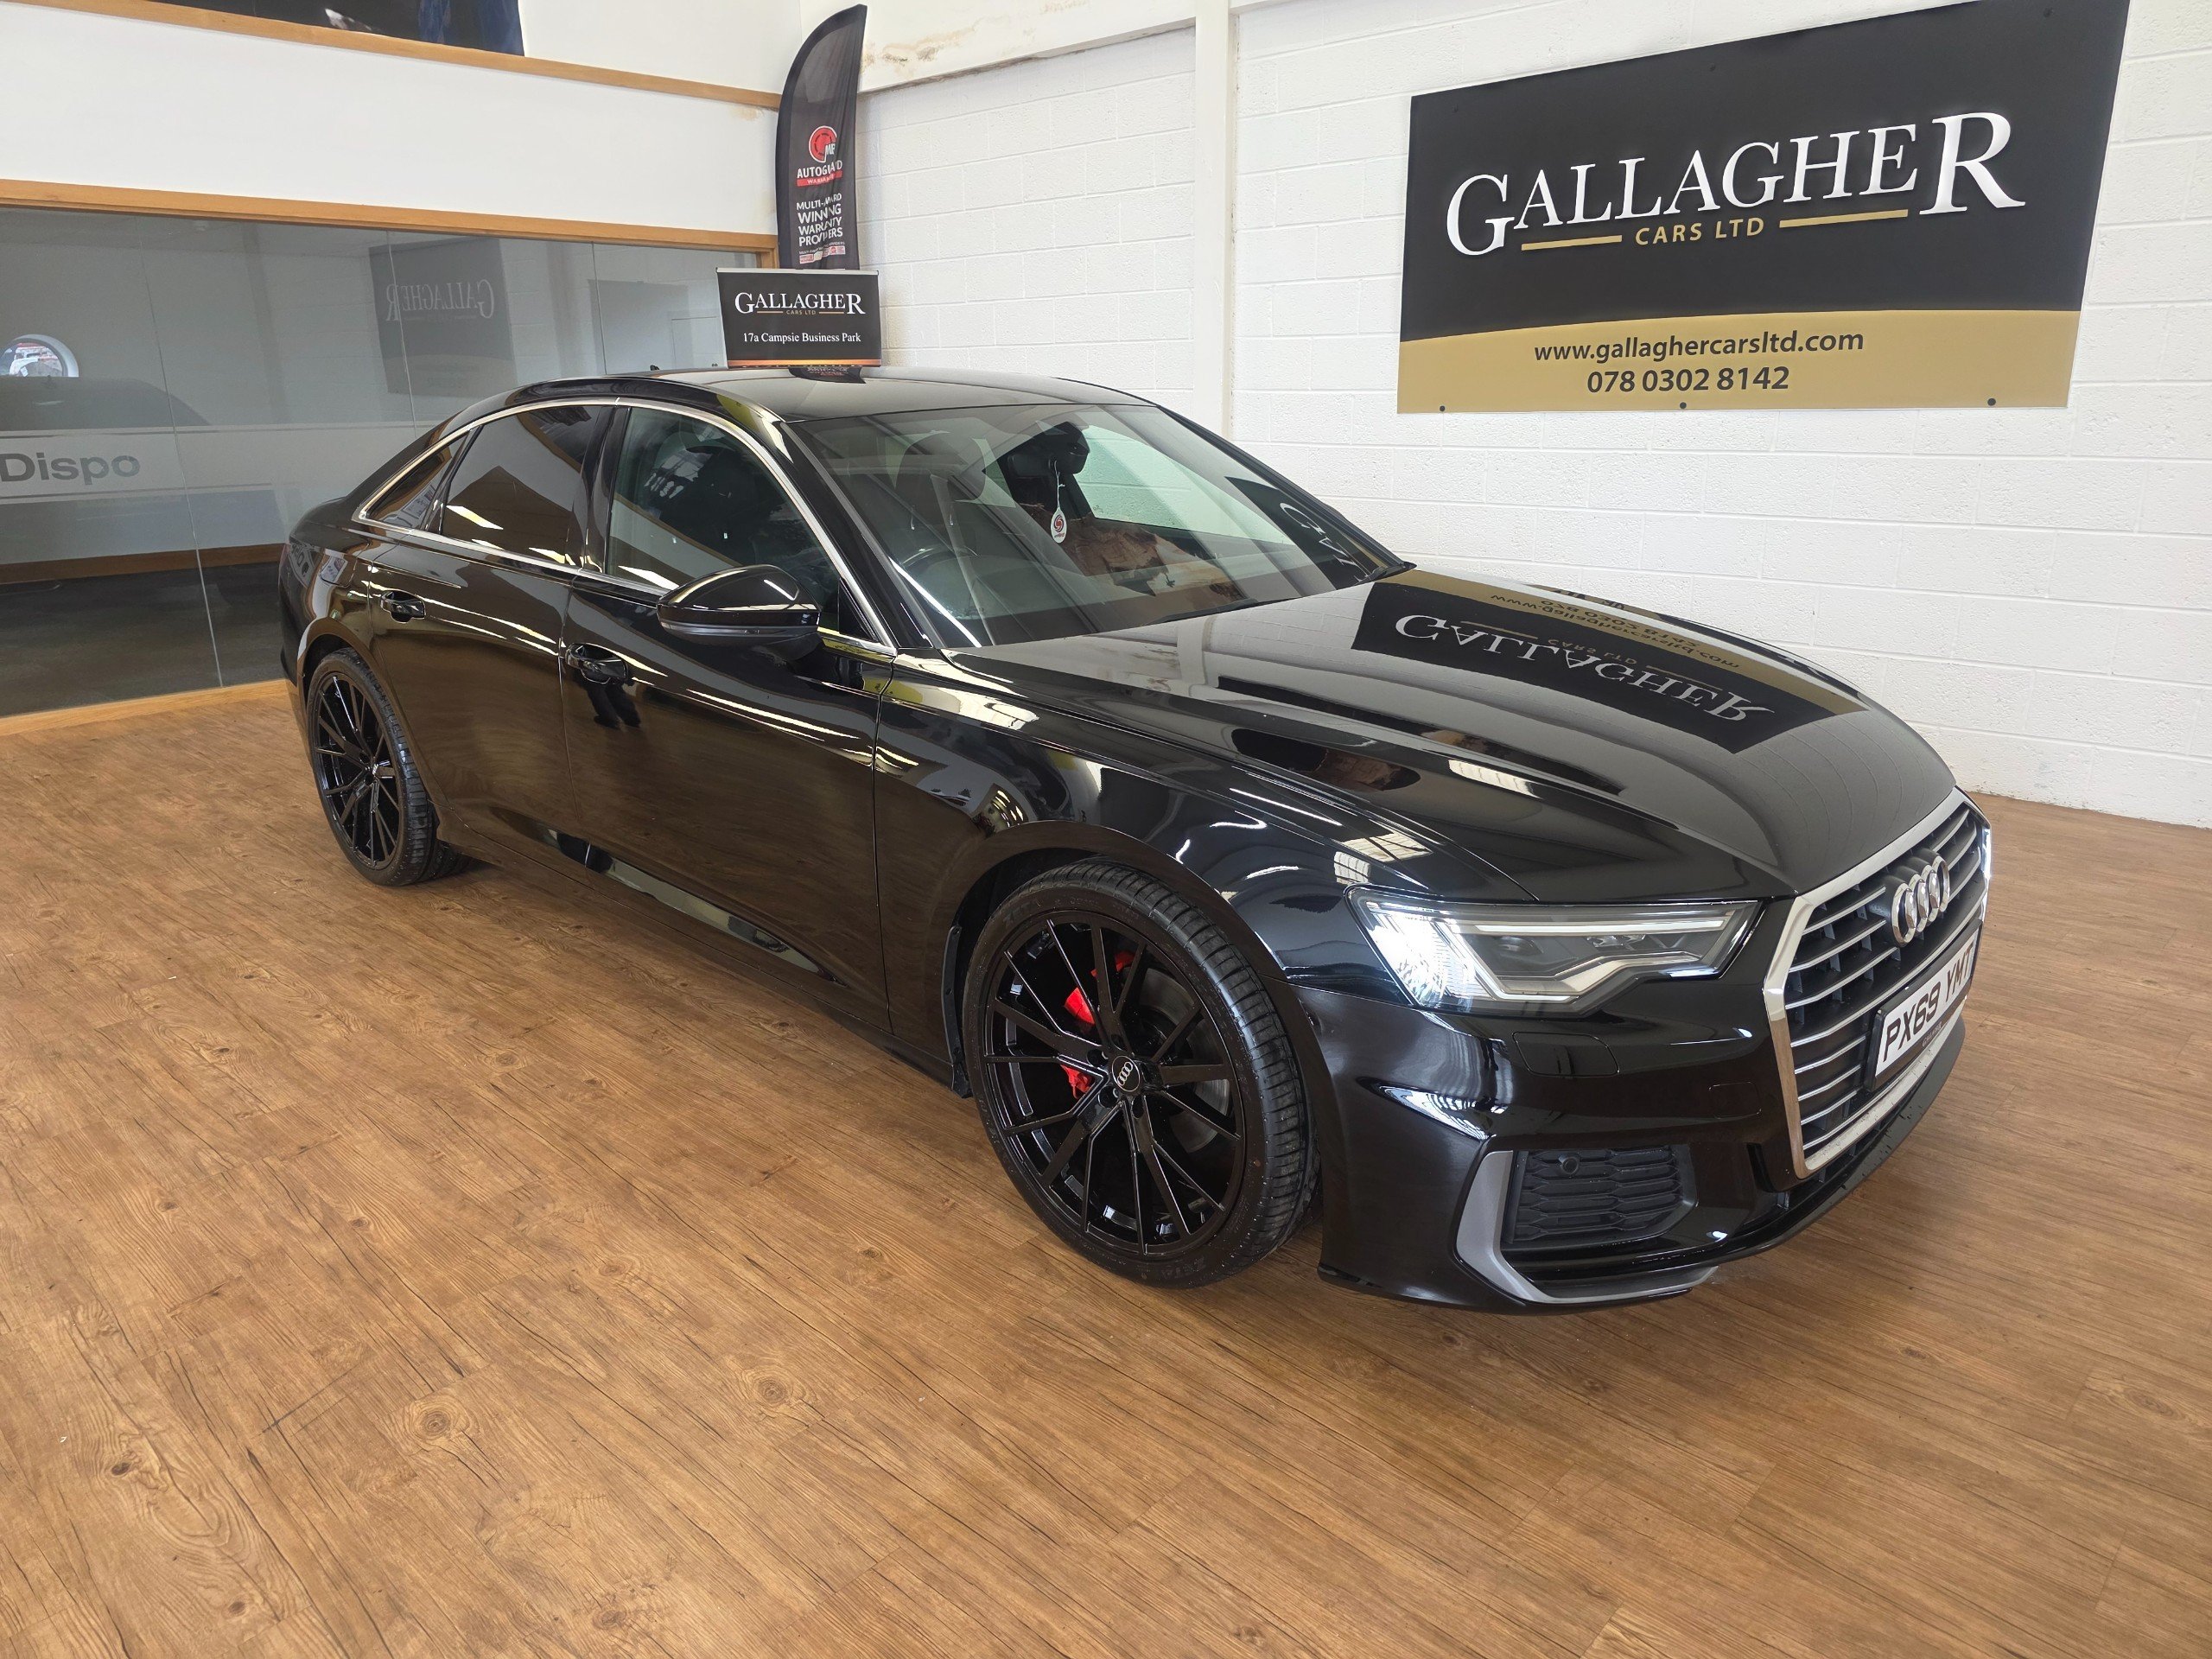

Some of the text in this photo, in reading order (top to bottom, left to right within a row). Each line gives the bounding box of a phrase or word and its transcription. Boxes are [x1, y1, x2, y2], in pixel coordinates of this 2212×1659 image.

[797, 160, 843, 179] AUTOGUAD
[1446, 111, 2026, 257] GALLAGHER
[796, 193, 842, 211] MULTI-WRD
[798, 203, 842, 224] WINNNG
[1635, 217, 1764, 246] CARS LTD
[734, 292, 866, 315] GALLAGHER
[743, 332, 861, 344] 17a Campsie Business Park
[1534, 330, 1865, 362] www.gallaghercarsltd.com
[1586, 365, 1789, 394] 078 0302 8142
[0, 452, 141, 486] Dispo
[1883, 981, 1942, 1063] PX69
[1945, 940, 1974, 1002] YMT
